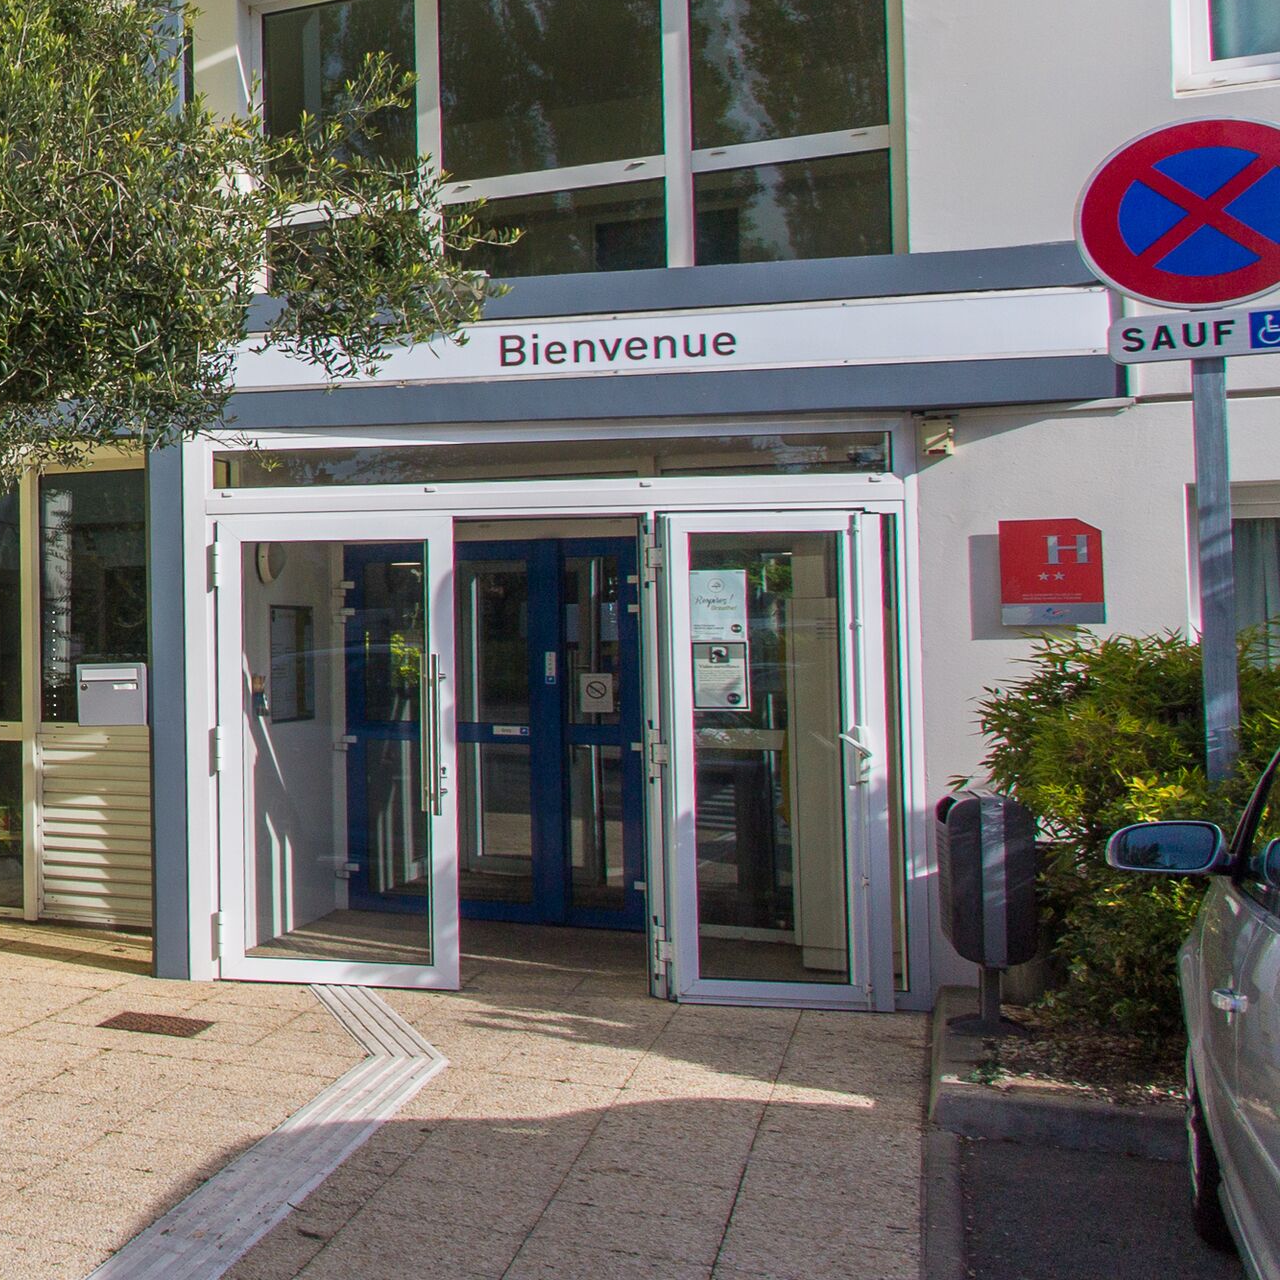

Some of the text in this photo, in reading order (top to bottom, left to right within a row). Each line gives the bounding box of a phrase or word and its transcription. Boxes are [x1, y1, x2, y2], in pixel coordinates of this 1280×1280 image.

[499, 331, 737, 367] Bienvenue
[1121, 320, 1236, 352] SAUF
[1040, 534, 1093, 565] H
